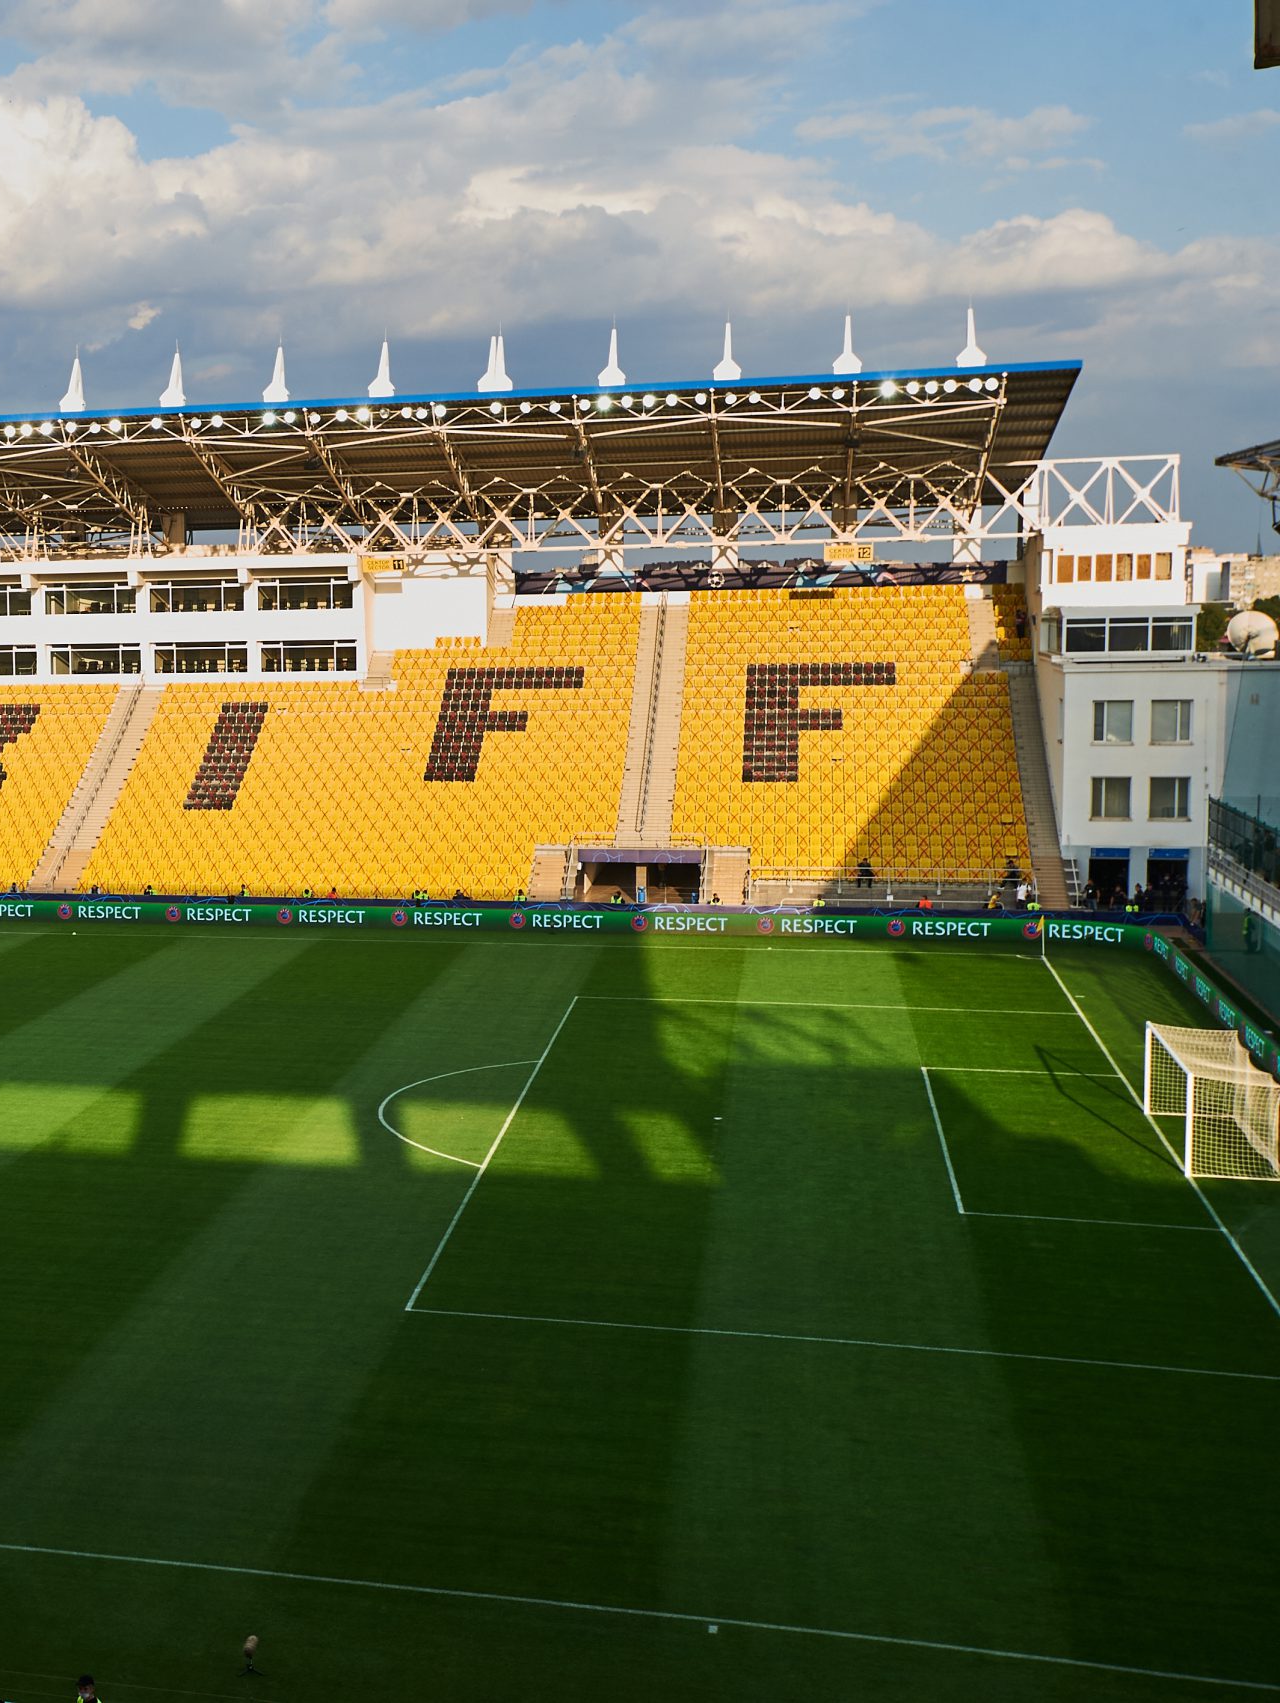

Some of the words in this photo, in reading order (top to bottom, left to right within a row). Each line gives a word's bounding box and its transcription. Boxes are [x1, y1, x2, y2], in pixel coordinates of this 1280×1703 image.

[858, 547, 871, 558] 12
[393, 560, 404, 569] 11
[78, 905, 142, 920] RESPECT
[186, 907, 252, 922] RESPECT
[298, 909, 366, 924] RESPECT
[413, 911, 483, 927] RESPECT
[532, 914, 604, 929] RESPECT
[654, 916, 729, 932] RESPECT
[780, 918, 858, 934] RESPECT
[912, 921, 992, 937] RESPECT
[1048, 923, 1125, 943] RESPECT
